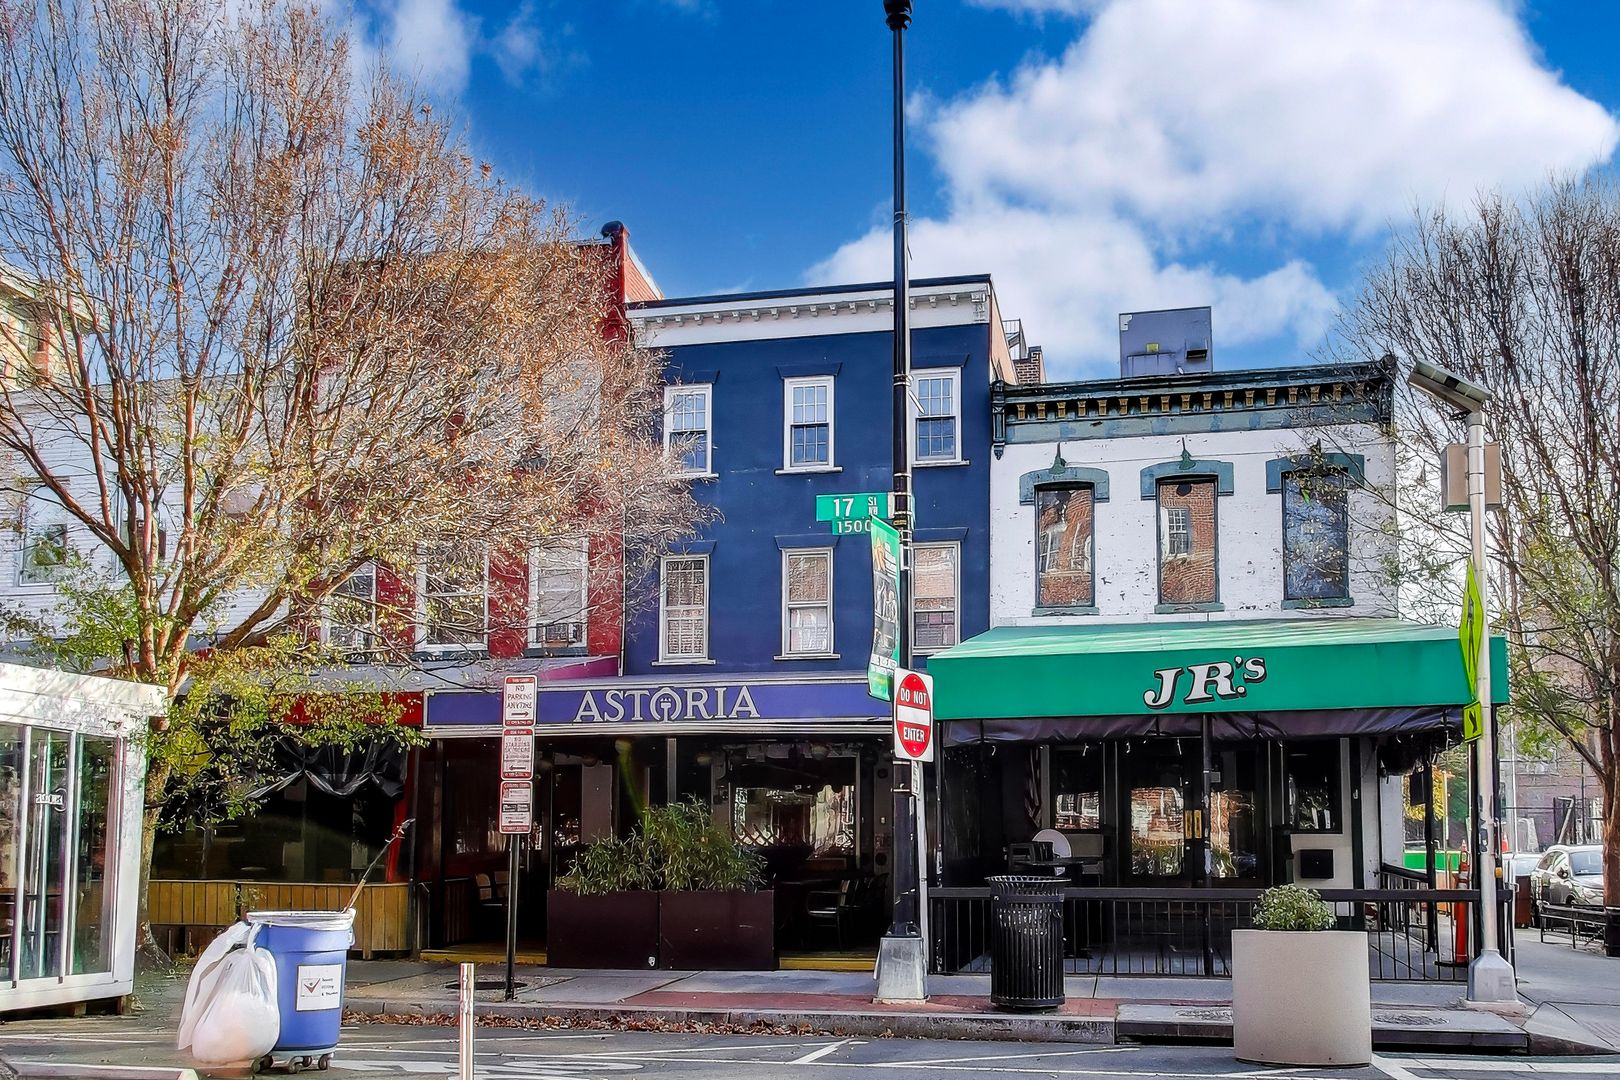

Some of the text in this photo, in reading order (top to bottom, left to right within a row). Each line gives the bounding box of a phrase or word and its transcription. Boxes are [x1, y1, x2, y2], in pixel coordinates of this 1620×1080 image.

[833, 498, 854, 517] 17
[507, 693, 532, 701] PARKING
[573, 685, 761, 723] ASTORIA
[900, 688, 927, 705] DO NOT
[506, 701, 532, 709] ANYTIME
[903, 727, 925, 742] ENTER
